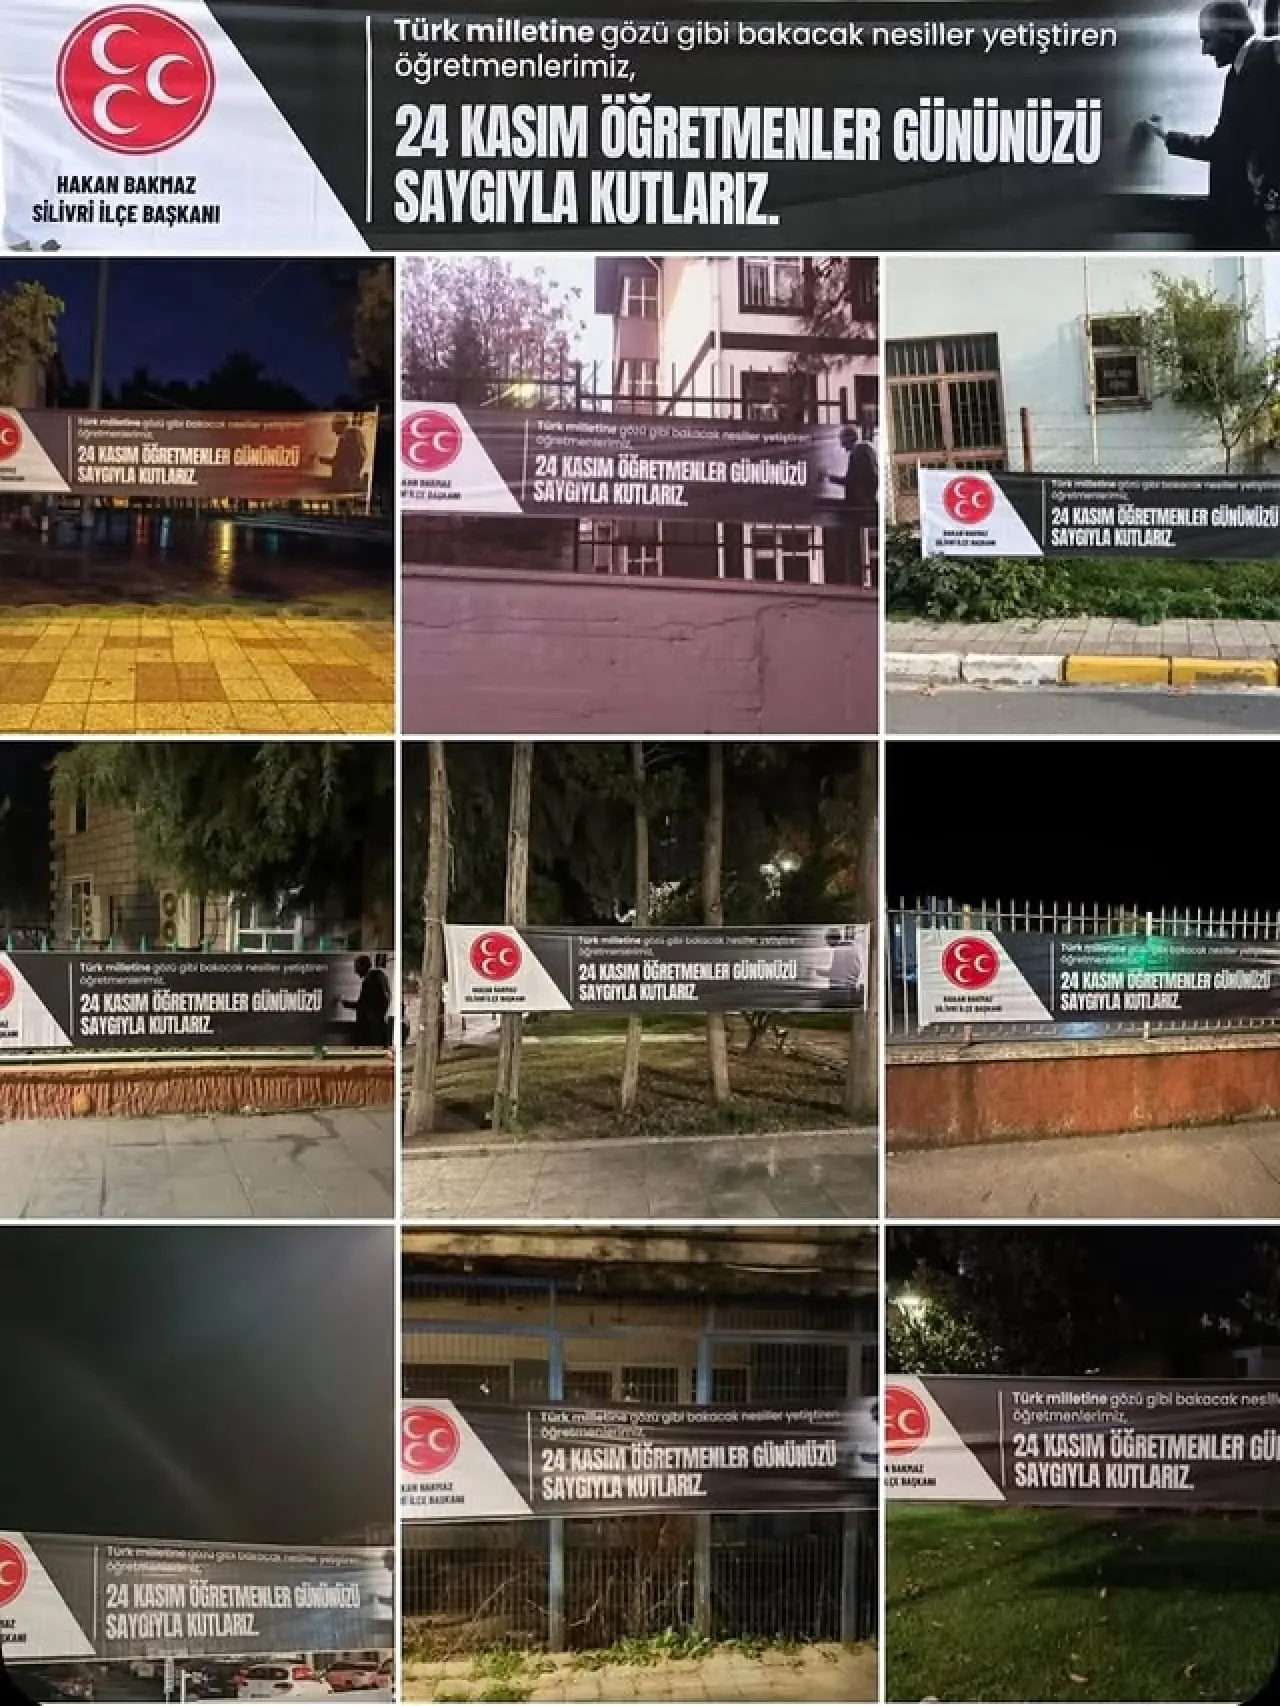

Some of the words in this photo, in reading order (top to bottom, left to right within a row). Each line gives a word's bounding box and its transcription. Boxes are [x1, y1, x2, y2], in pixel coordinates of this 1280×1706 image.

[395, 18, 459, 43] Türk
[466, 18, 596, 45] milletine
[601, 22, 669, 50] gözü
[677, 21, 729, 50] gibi
[738, 21, 864, 48] bakacak
[872, 22, 975, 48] nesiller
[983, 22, 1117, 53] yetiştiren
[394, 53, 636, 83] öğretmenlerimiz,
[395, 104, 449, 159] 24
[460, 104, 587, 159] KASIM
[600, 93, 880, 161] ÖĞRETMENLER
[892, 96, 1102, 165] GÜNÜNÜZÜ
[57, 175, 118, 195] HAKAN
[123, 175, 197, 195] BAKMAZ
[394, 168, 571, 225] SAYGIYLA
[591, 168, 780, 226] KUTLARIZ.
[31, 202, 95, 224] SİLİVRİ
[98, 204, 139, 227] İLÇE
[143, 205, 221, 228] BAŞKANI
[77, 445, 96, 463] 24
[535, 453, 558, 477] 24
[561, 454, 615, 479] KASIM
[617, 452, 728, 484] ÖĞRETMENLER
[730, 457, 808, 487] GÜNÜNÜZÜ
[533, 478, 610, 503] SAYGIYLA
[613, 482, 689, 507] KUTLARIZ.
[1051, 507, 1069, 526] 24
[1072, 507, 1115, 526] KASIM
[578, 962, 597, 981] 24
[599, 963, 641, 981] KASIM
[643, 959, 731, 981] ÖĞRETMENLER
[1060, 971, 1079, 991] 24
[1081, 971, 1125, 991] KASIM
[80, 993, 100, 1013] 24
[103, 993, 149, 1013] KASIM
[151, 987, 249, 1013] ÖĞRETMENLER
[578, 983, 637, 1001] SAYGIYLA
[639, 983, 699, 1001] KUTLARIZ.
[80, 1014, 145, 1035] SAYGIYLA
[149, 1014, 215, 1035] KUTLARIZ.
[1011, 1391, 1043, 1405] Türk
[1045, 1391, 1107, 1405] milletine
[1109, 1391, 1143, 1409] gözü
[1145, 1391, 1173, 1409] gibi
[1175, 1391, 1238, 1406] bakacak
[541, 1447, 565, 1472] 24
[570, 1446, 626, 1472] KASIM
[631, 1441, 749, 1470] ÖĞRETMENLER
[752, 1439, 837, 1469] GÜNÜNÜZÜ
[1013, 1433, 1039, 1458] 24
[1043, 1433, 1105, 1459] KASIM
[1110, 1428, 1245, 1460] ÖĞRETMENLER
[541, 1474, 623, 1501] SAYGIYLA
[627, 1472, 708, 1499] KUTLARIZ.
[1013, 1461, 1101, 1489] SAYGIYLA
[1105, 1462, 1195, 1490] KUTLARIZ.
[106, 1583, 129, 1608] 24
[133, 1583, 186, 1608] KASIM
[189, 1579, 293, 1608] ÖĞRETMENLER
[105, 1612, 183, 1639] SAYGIYLA
[187, 1611, 260, 1638] KUTLARIZ.
